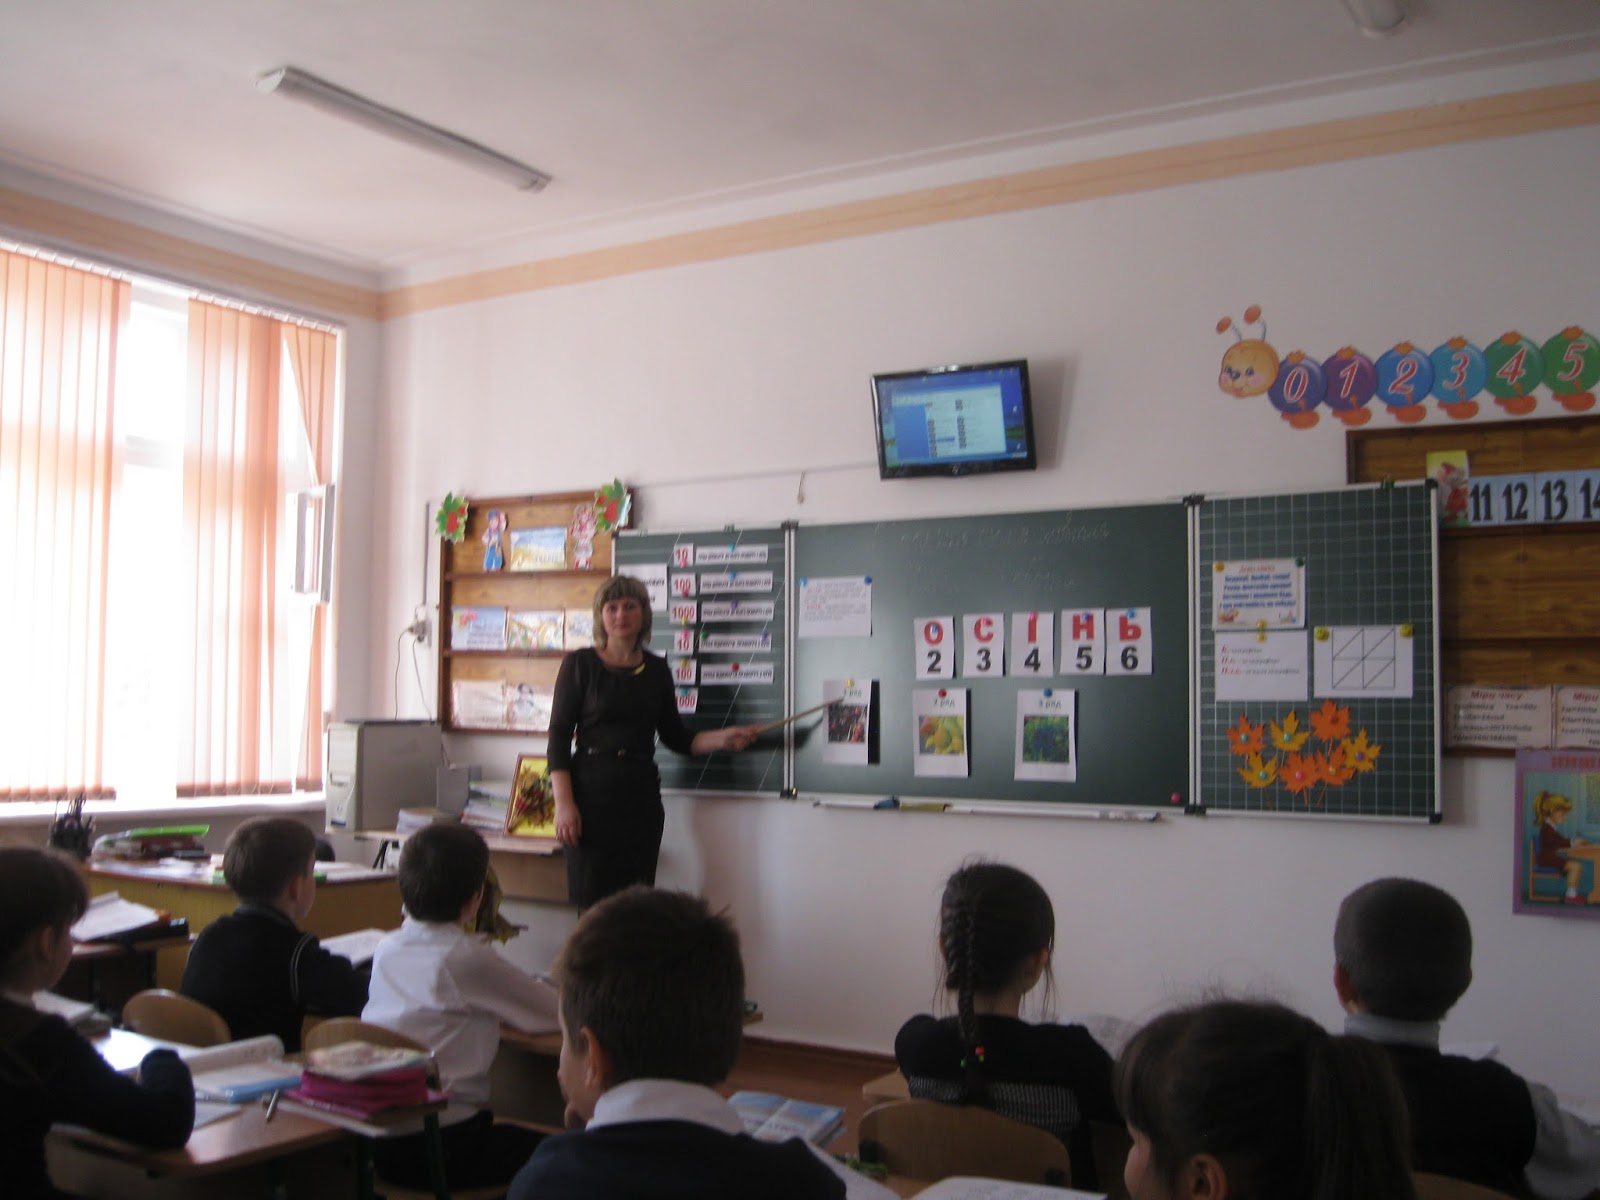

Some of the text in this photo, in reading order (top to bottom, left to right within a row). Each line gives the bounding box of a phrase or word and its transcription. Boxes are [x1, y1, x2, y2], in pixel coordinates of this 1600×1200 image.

[1283, 342, 1589, 403] 0 1 2 3 4 5
[1469, 483, 1492, 522] 11
[1502, 482, 1529, 521] 12
[1540, 479, 1568, 520] 13
[675, 548, 688, 561] 10
[674, 577, 691, 591] 100
[672, 606, 695, 619] 1000
[677, 639, 690, 652] 10
[927, 646, 1139, 673] 2 3 4 5 6
[675, 667, 692, 680] 100
[1471, 690, 1495, 701] Міри
